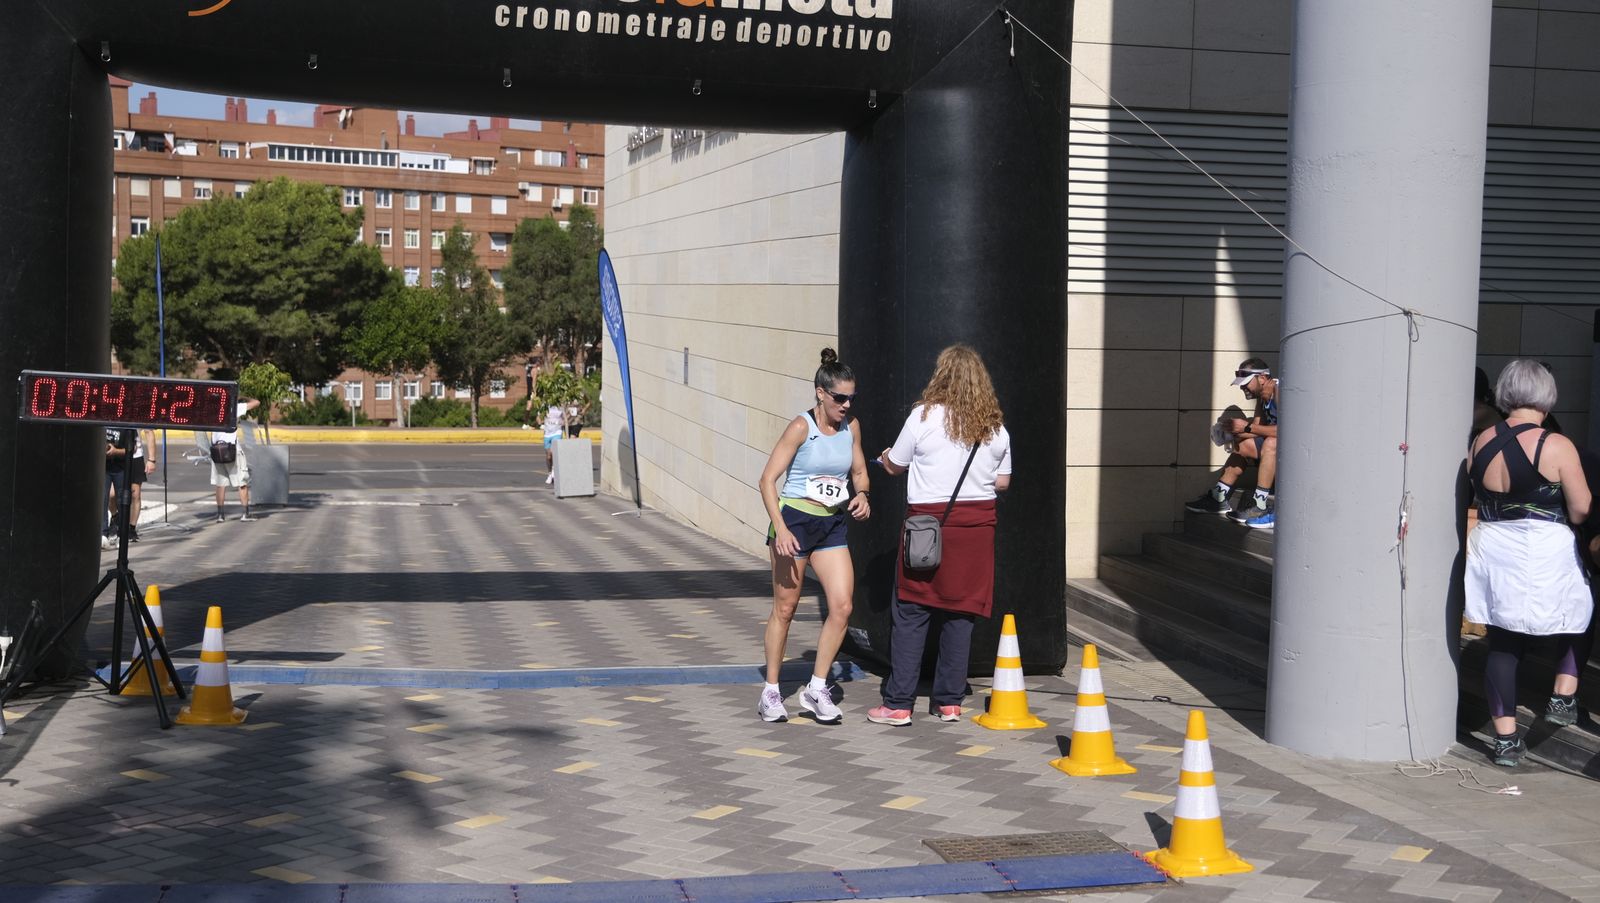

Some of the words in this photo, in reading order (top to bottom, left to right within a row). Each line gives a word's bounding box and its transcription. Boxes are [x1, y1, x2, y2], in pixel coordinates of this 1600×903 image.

[494, 4, 726, 43] cronometraje
[735, 17, 893, 52] deportivo
[816, 483, 842, 498] 157
